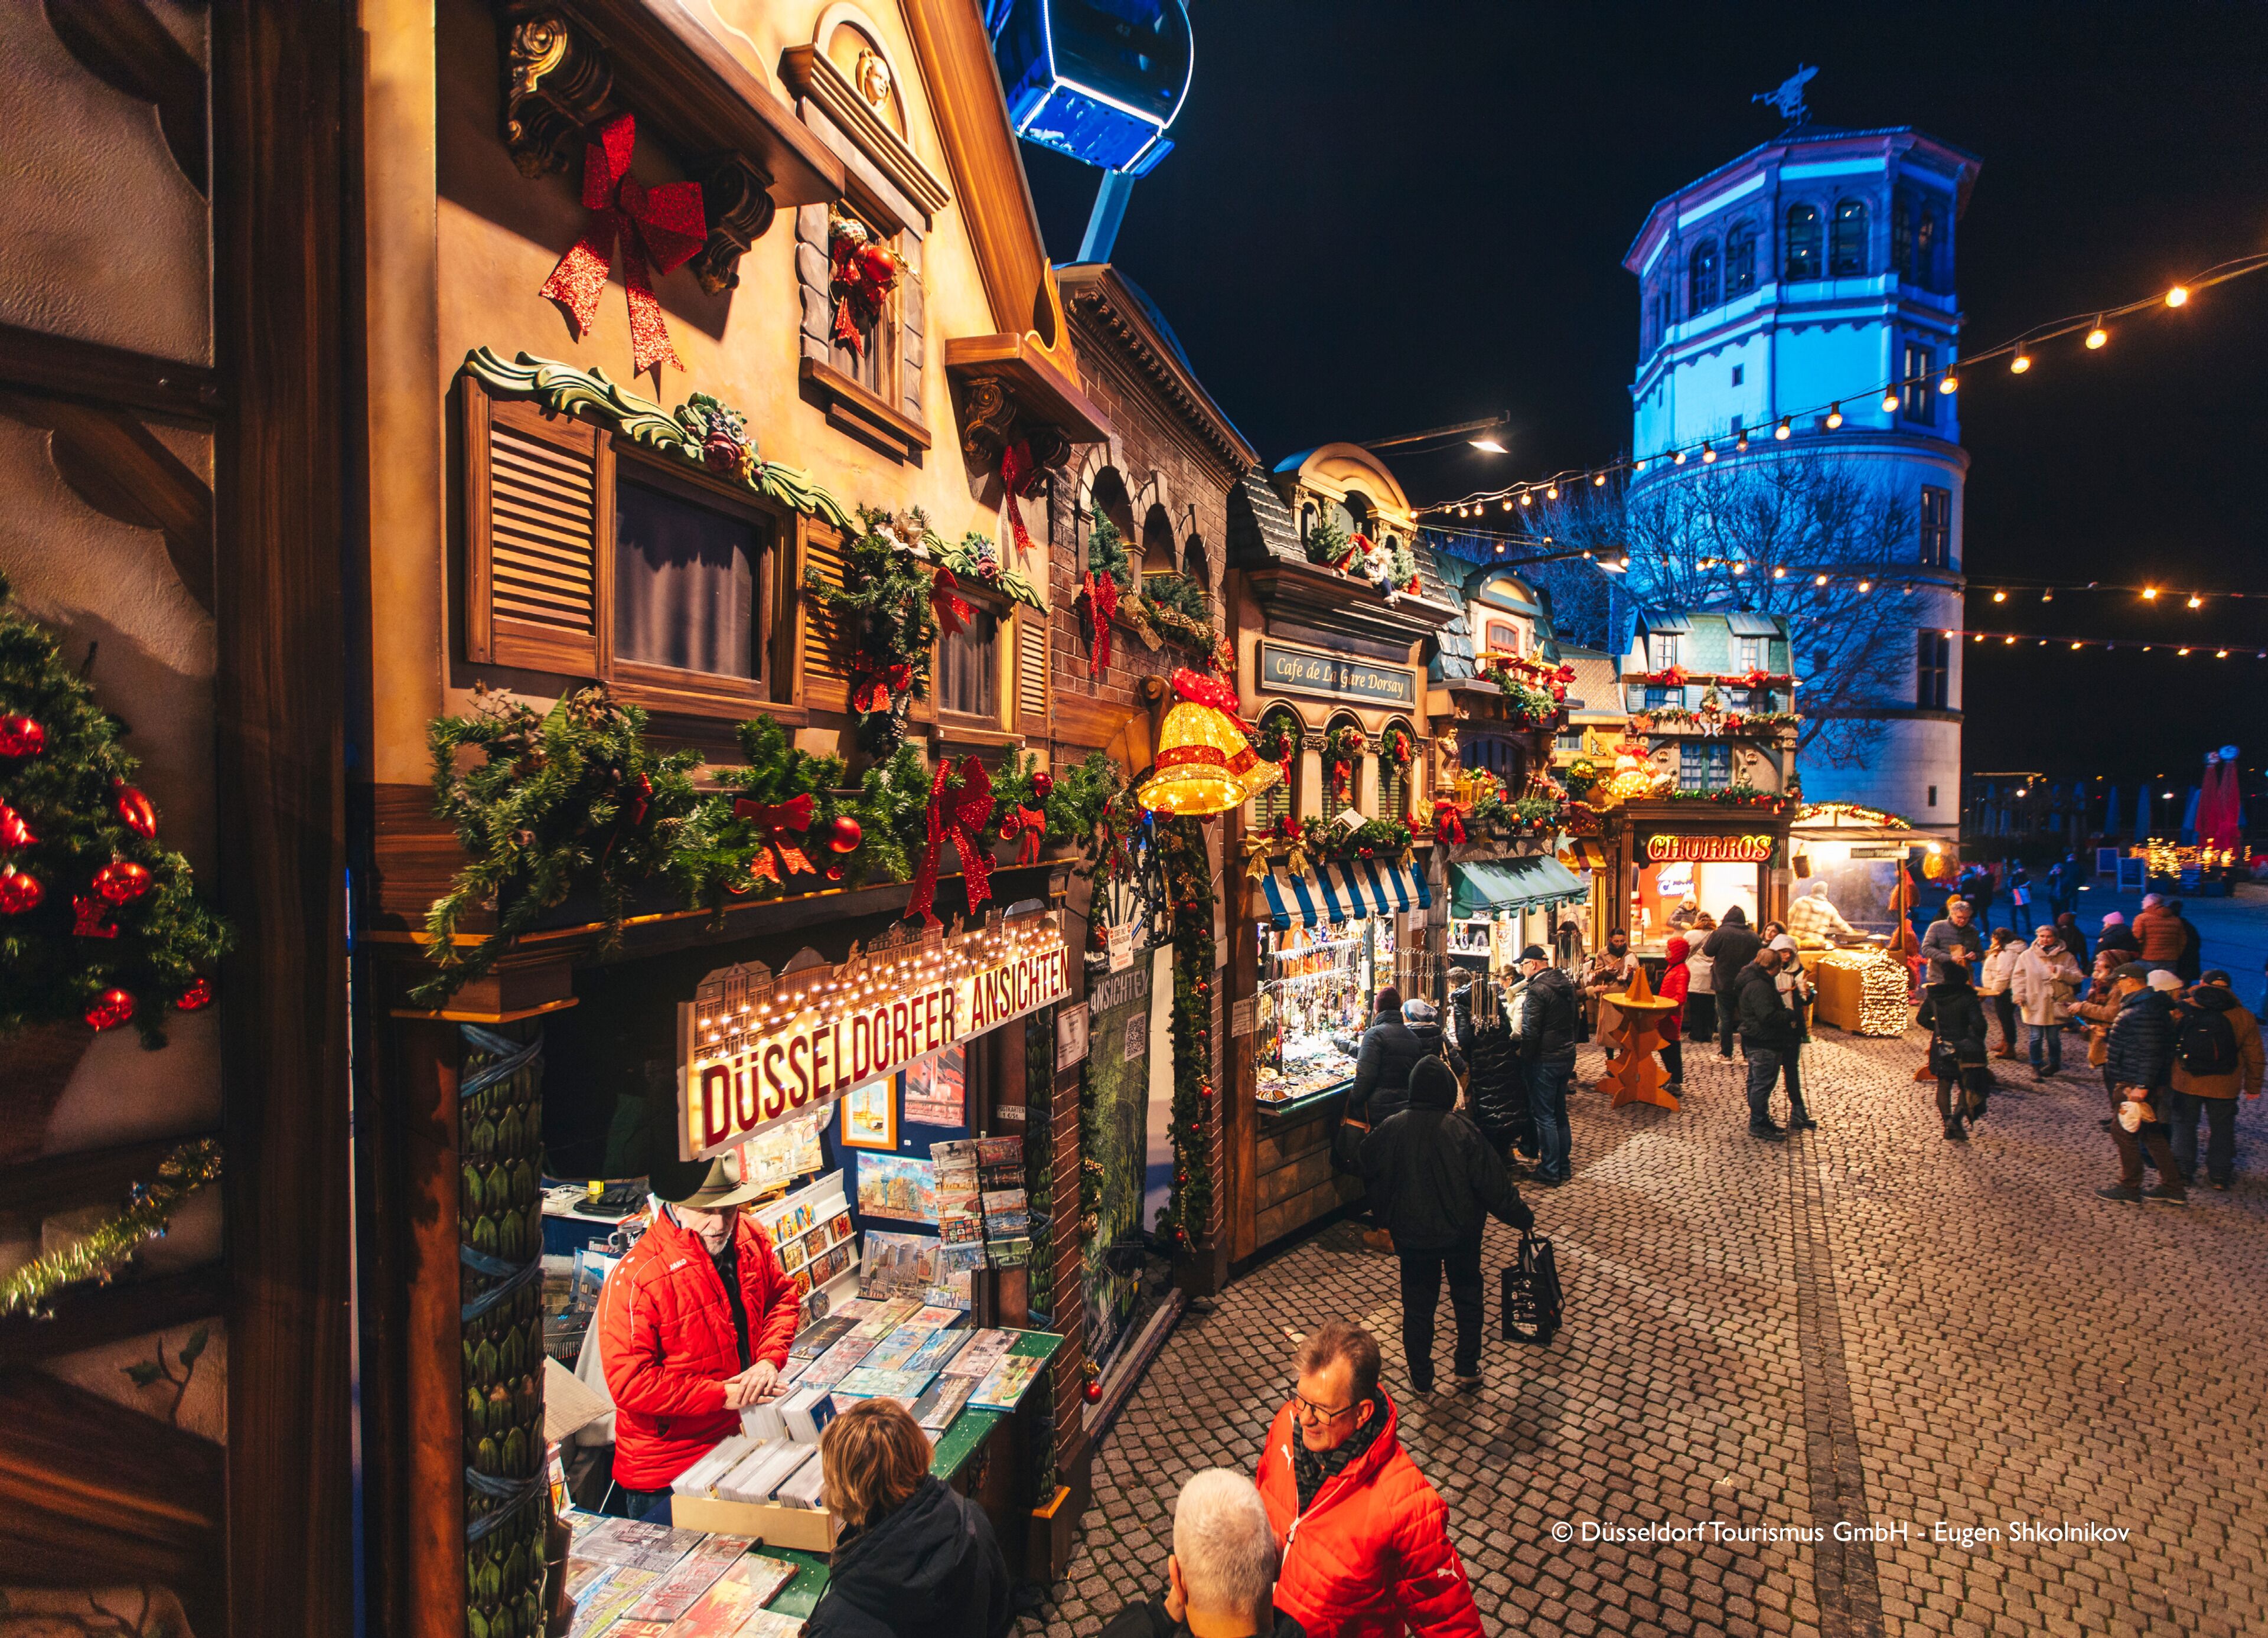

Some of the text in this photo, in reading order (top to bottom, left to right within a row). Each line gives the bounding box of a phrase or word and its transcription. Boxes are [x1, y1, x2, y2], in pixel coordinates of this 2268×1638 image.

[1276, 657, 1404, 699] Cafe de La Gare Dorsay
[1647, 833, 1772, 861] CHURROS
[703, 946, 1070, 1146] DÜSSELDORFER ANSICHTEN
[669, 1258, 687, 1271] JAKO
